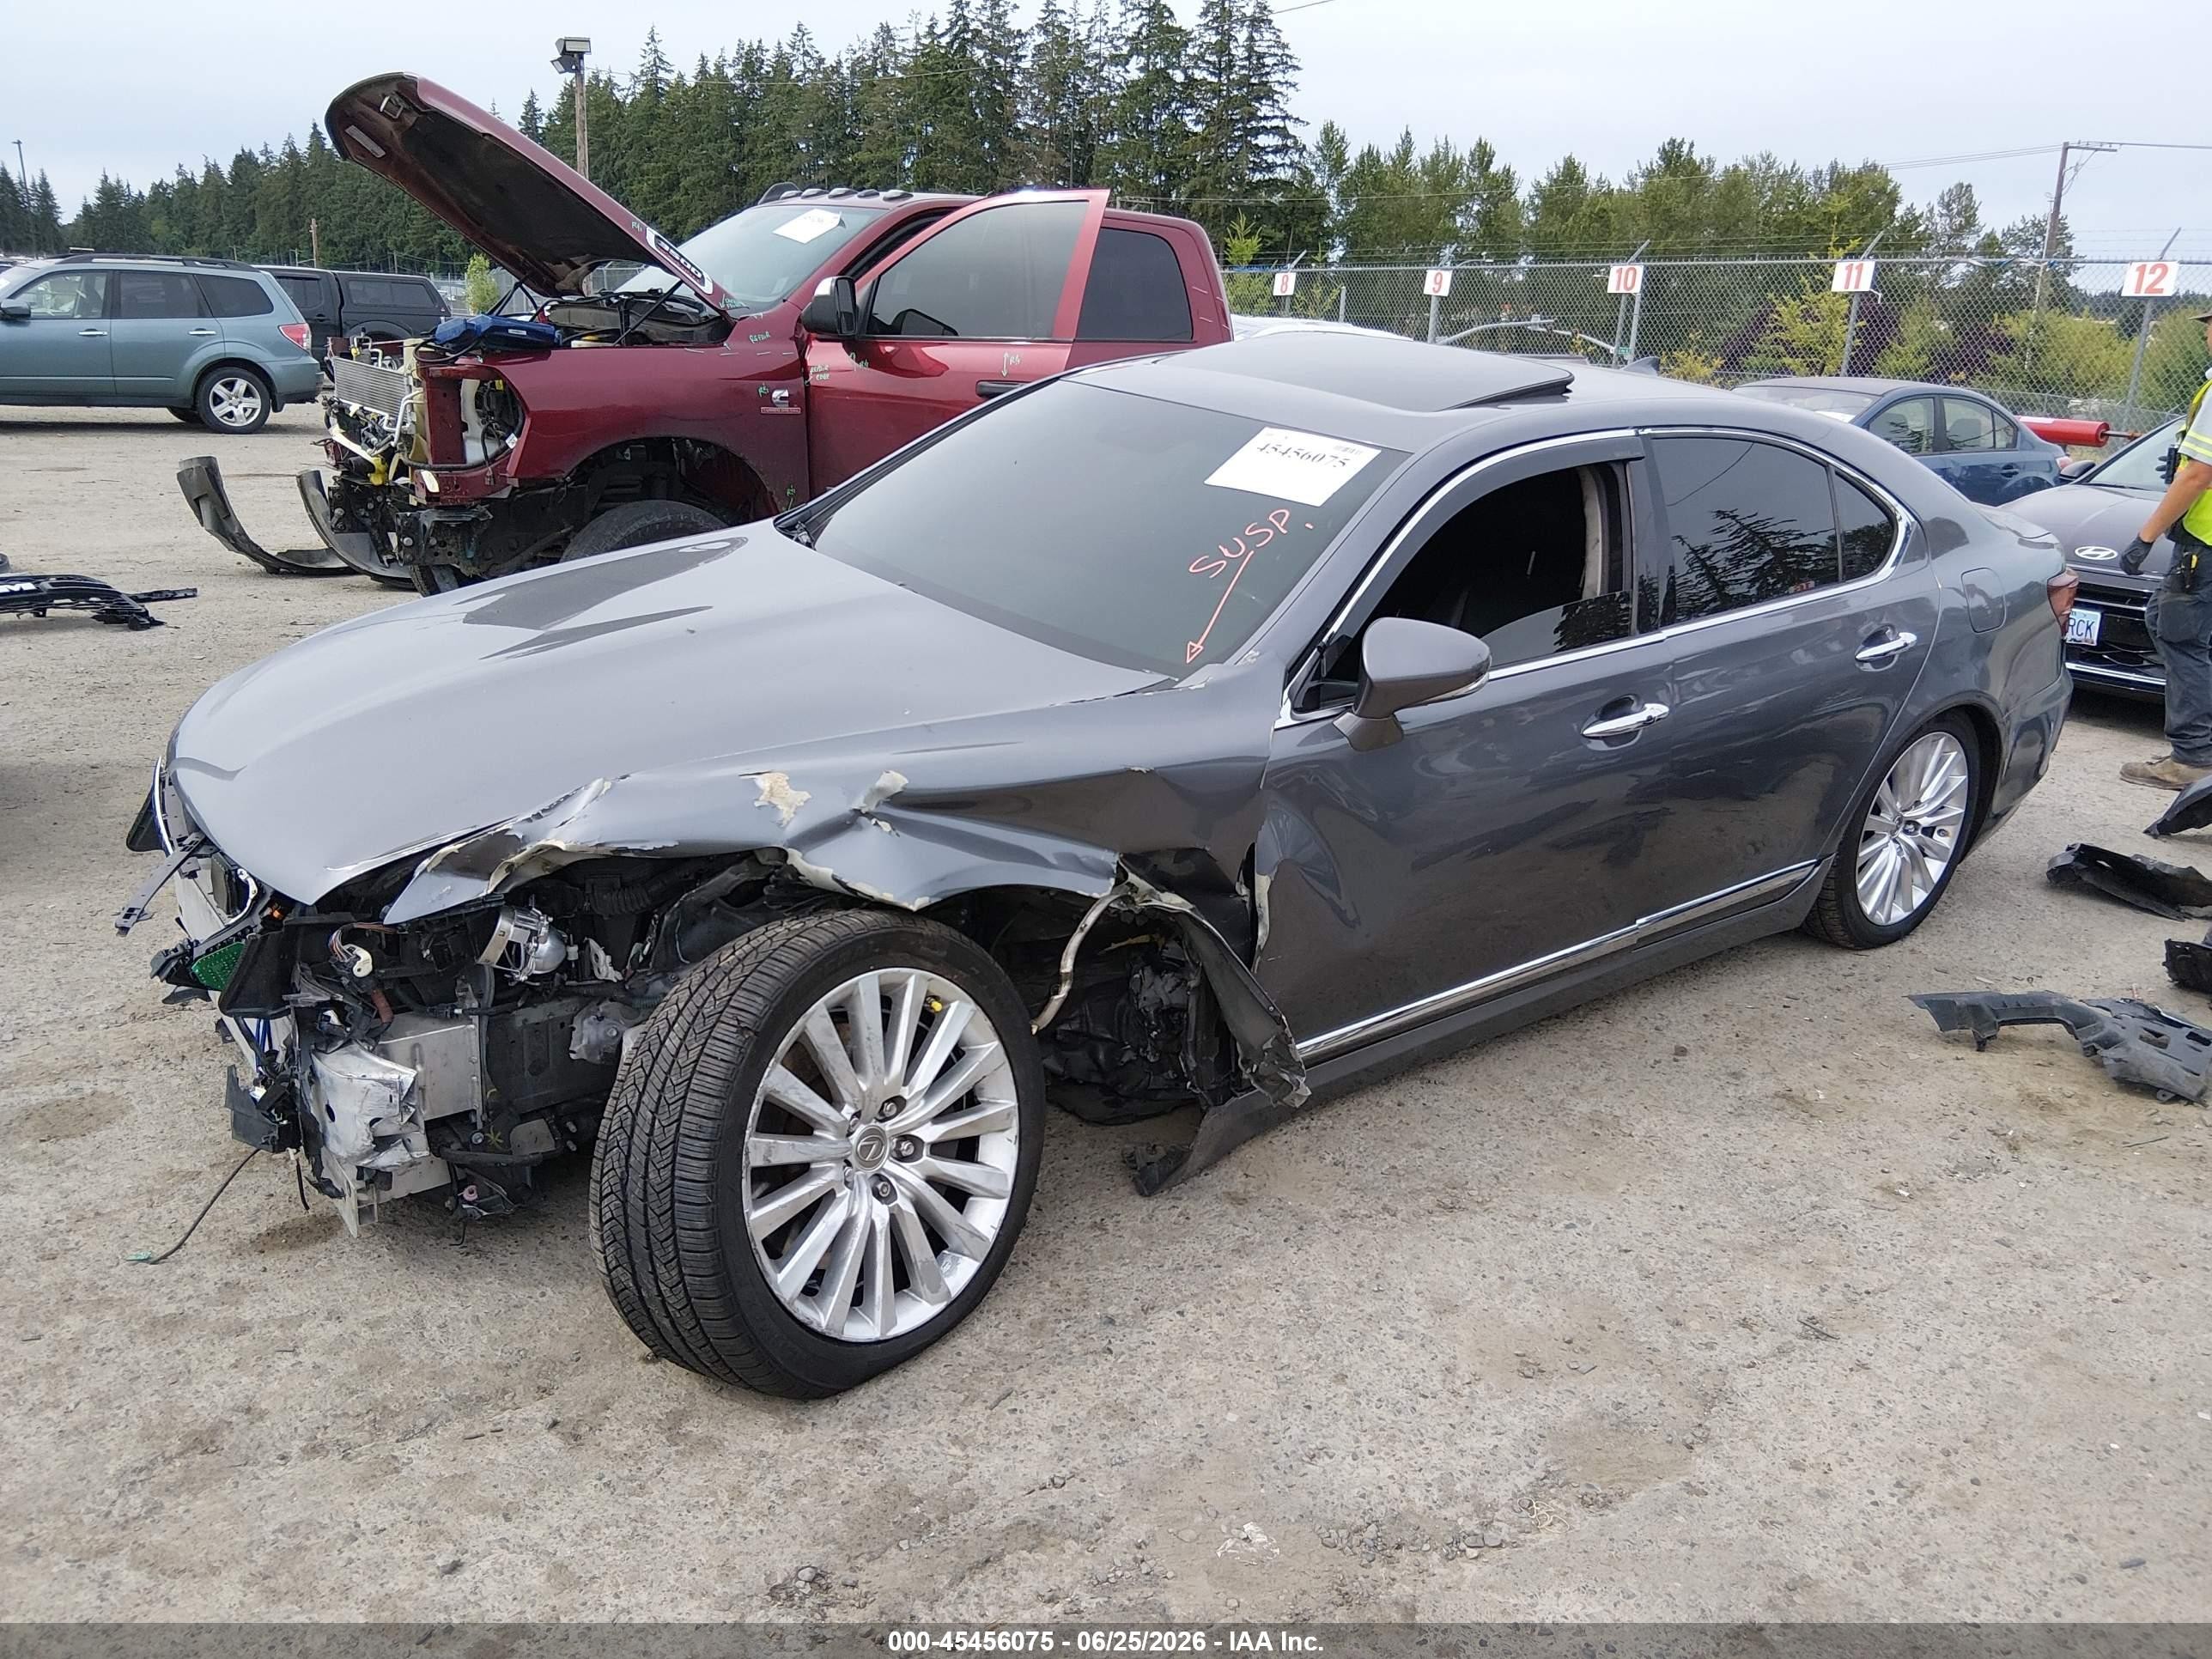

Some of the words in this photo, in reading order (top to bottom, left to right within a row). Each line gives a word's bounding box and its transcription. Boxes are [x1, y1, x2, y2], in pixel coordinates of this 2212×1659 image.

[1279, 274, 1289, 294] 8
[1432, 271, 1443, 294] 9
[1615, 266, 1638, 292] 10
[1844, 263, 1864, 289] 11
[2134, 263, 2168, 295] 12
[1256, 441, 1351, 468] 45456075
